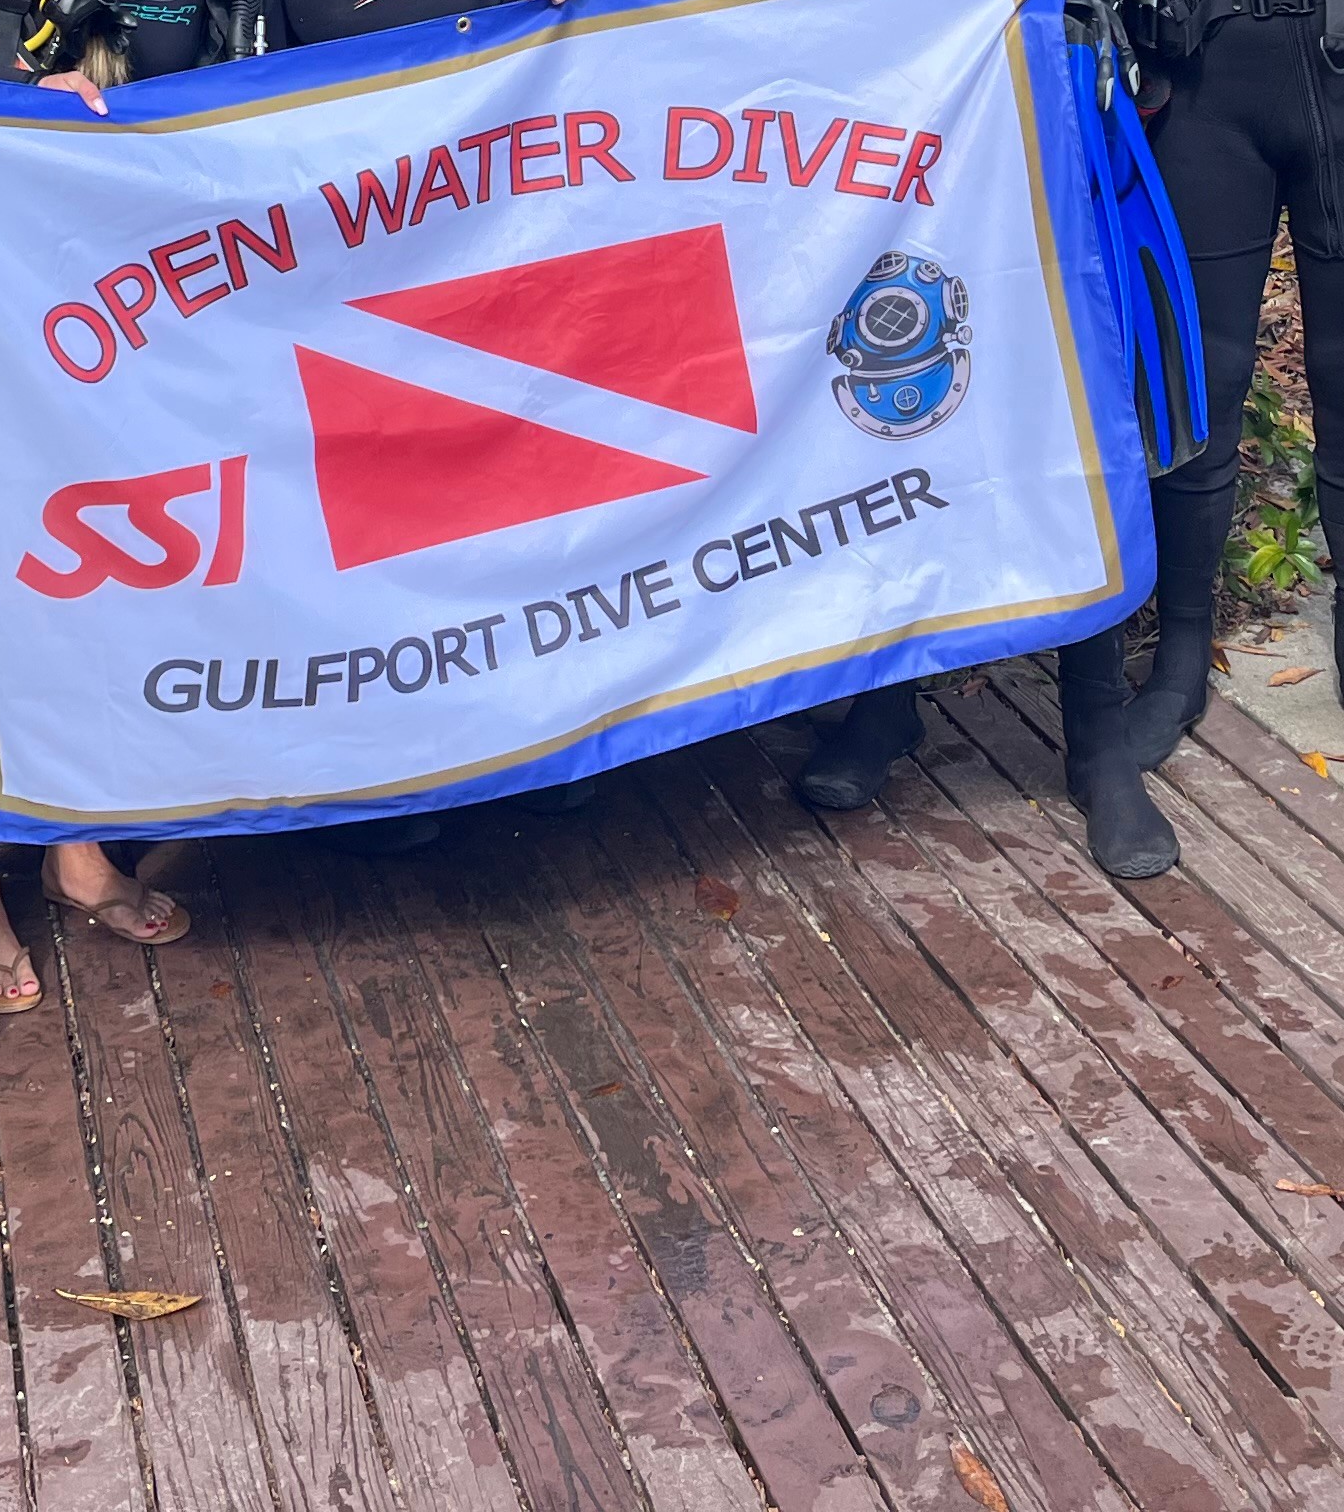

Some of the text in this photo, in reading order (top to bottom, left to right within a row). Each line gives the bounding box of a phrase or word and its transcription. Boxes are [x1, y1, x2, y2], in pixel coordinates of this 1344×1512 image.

[42, 106, 942, 384] OPEN WATER DIVER
[15, 455, 248, 600] SSI
[144, 468, 950, 713] GULFPORT DIVE CENTER
